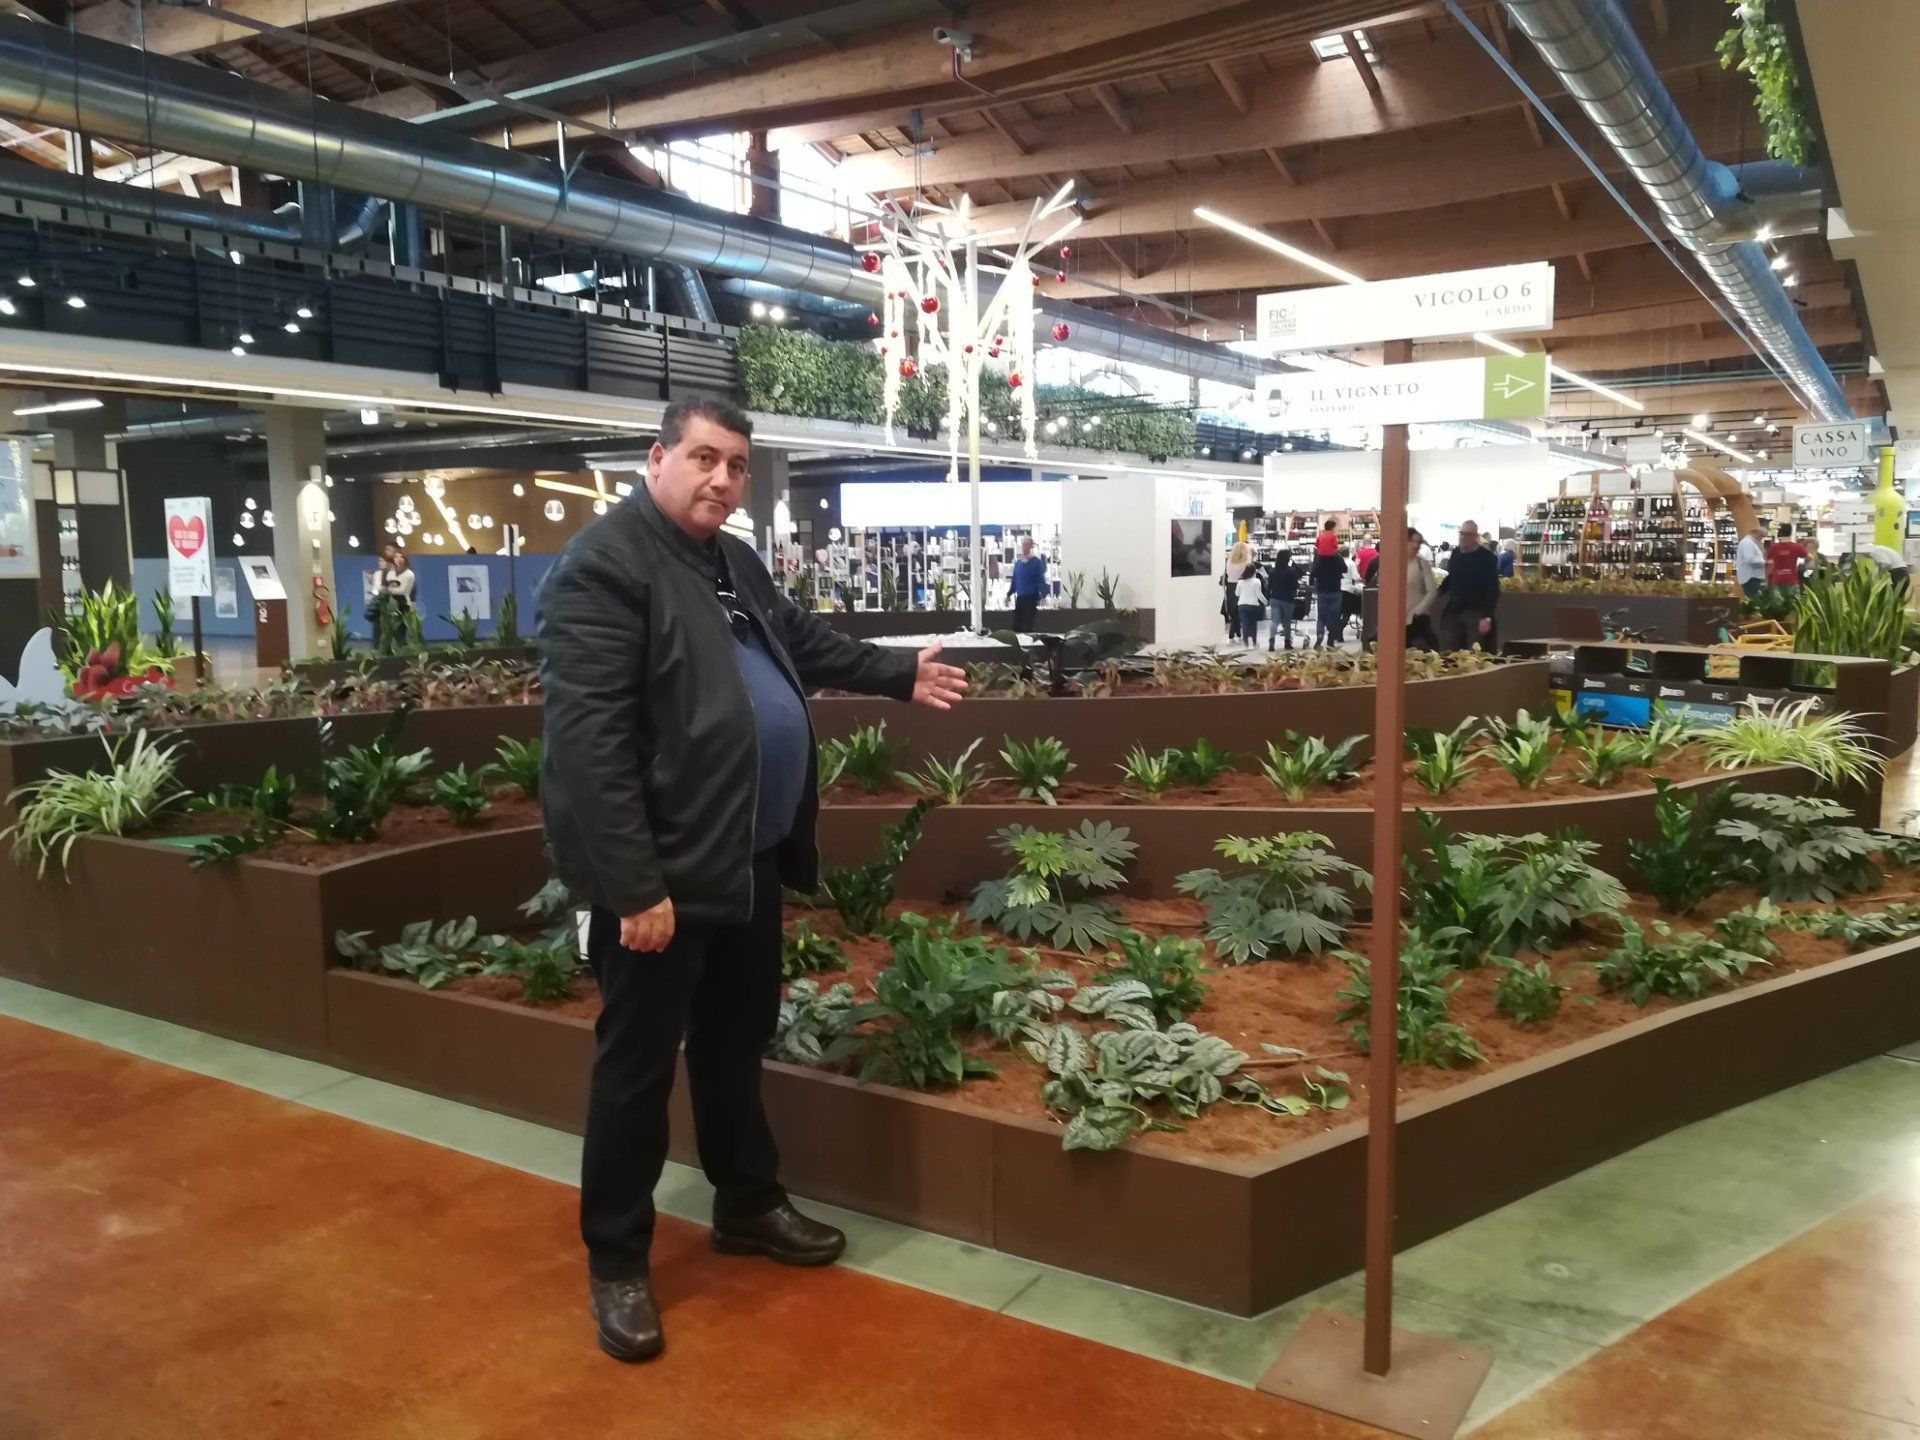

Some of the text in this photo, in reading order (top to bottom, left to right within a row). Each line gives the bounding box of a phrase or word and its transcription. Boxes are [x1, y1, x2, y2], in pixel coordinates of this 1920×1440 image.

[1414, 281, 1532, 308] VICOLO 6
[1485, 303, 1532, 316] CARDO
[1336, 383, 1419, 399] VIGNETO
[1800, 430, 1858, 445] CASSA
[1810, 446, 1848, 458] VINO
